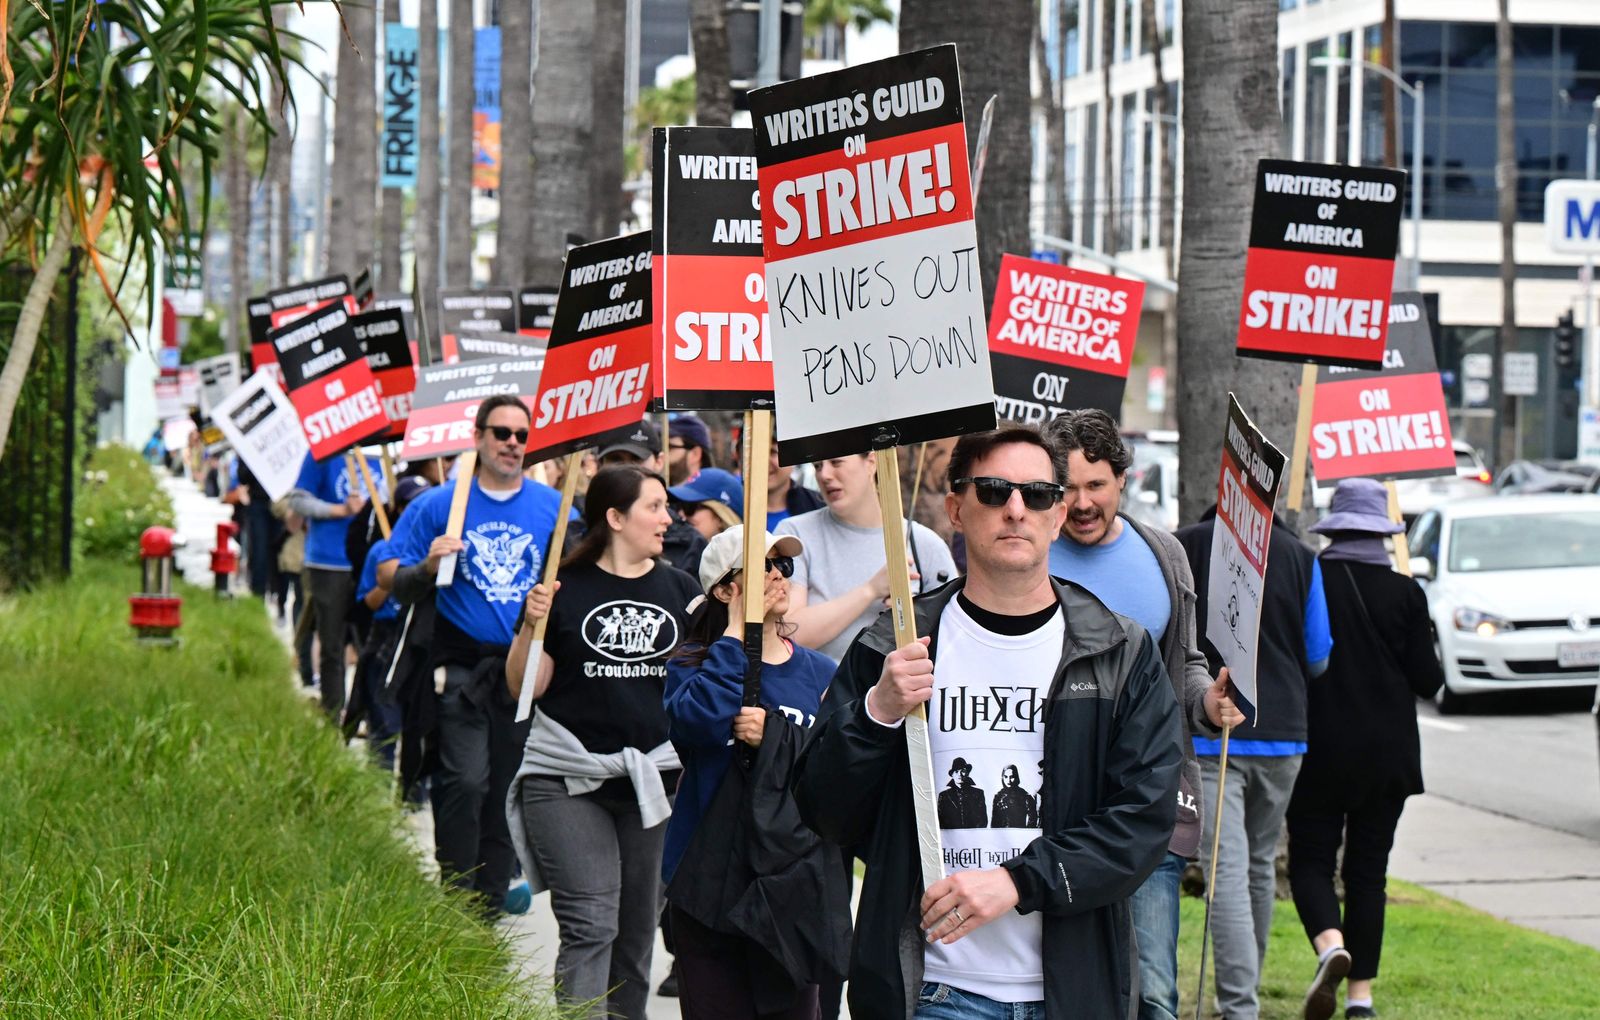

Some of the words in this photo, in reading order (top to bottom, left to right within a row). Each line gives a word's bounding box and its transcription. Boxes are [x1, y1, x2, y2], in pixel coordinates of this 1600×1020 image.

[385, 50, 417, 177] FRINGE
[764, 91, 869, 147] WRITERS
[873, 77, 945, 119] GUILD
[844, 134, 866, 158] ON
[678, 155, 759, 181] WRITE
[772, 142, 956, 247] STRIKE!
[1265, 172, 1342, 198] WRITERS
[1344, 179, 1397, 203] GUILD
[1317, 203, 1338, 221] OF
[1284, 223, 1364, 249] AMERICA
[570, 255, 634, 288] WRITERS
[744, 273, 769, 302] O
[776, 260, 895, 328] KNIVES
[913, 247, 976, 299] OUT
[1304, 265, 1338, 290] ON
[609, 282, 627, 300] OF
[1009, 270, 1128, 315] WRITERS
[274, 321, 320, 353] WRITERS
[317, 309, 347, 334] GUILD
[578, 299, 643, 332] AMERICA
[1009, 296, 1093, 332] GUILD
[1092, 319, 1121, 338] OF
[1245, 290, 1384, 341] STRIKE!
[674, 311, 774, 362] STRI
[996, 319, 1123, 364] AMERICA
[425, 362, 498, 384] WRITERS
[500, 360, 545, 373] GUIL
[588, 344, 618, 371] ON
[802, 342, 876, 402] PENS
[888, 316, 978, 380] DOWN
[324, 378, 346, 401] ON
[444, 383, 519, 402] AMERICA
[475, 375, 494, 386] OF
[535, 362, 650, 429] STRIKE!
[1033, 372, 1069, 403] ON
[303, 385, 382, 445] STRIKE!
[464, 405, 479, 418] O
[1359, 389, 1391, 411] ON
[1312, 411, 1446, 460] STRIKE!
[1228, 416, 1252, 470] WRITERS
[1251, 452, 1274, 493] GUILD
[1222, 466, 1266, 566] STRIKE!
